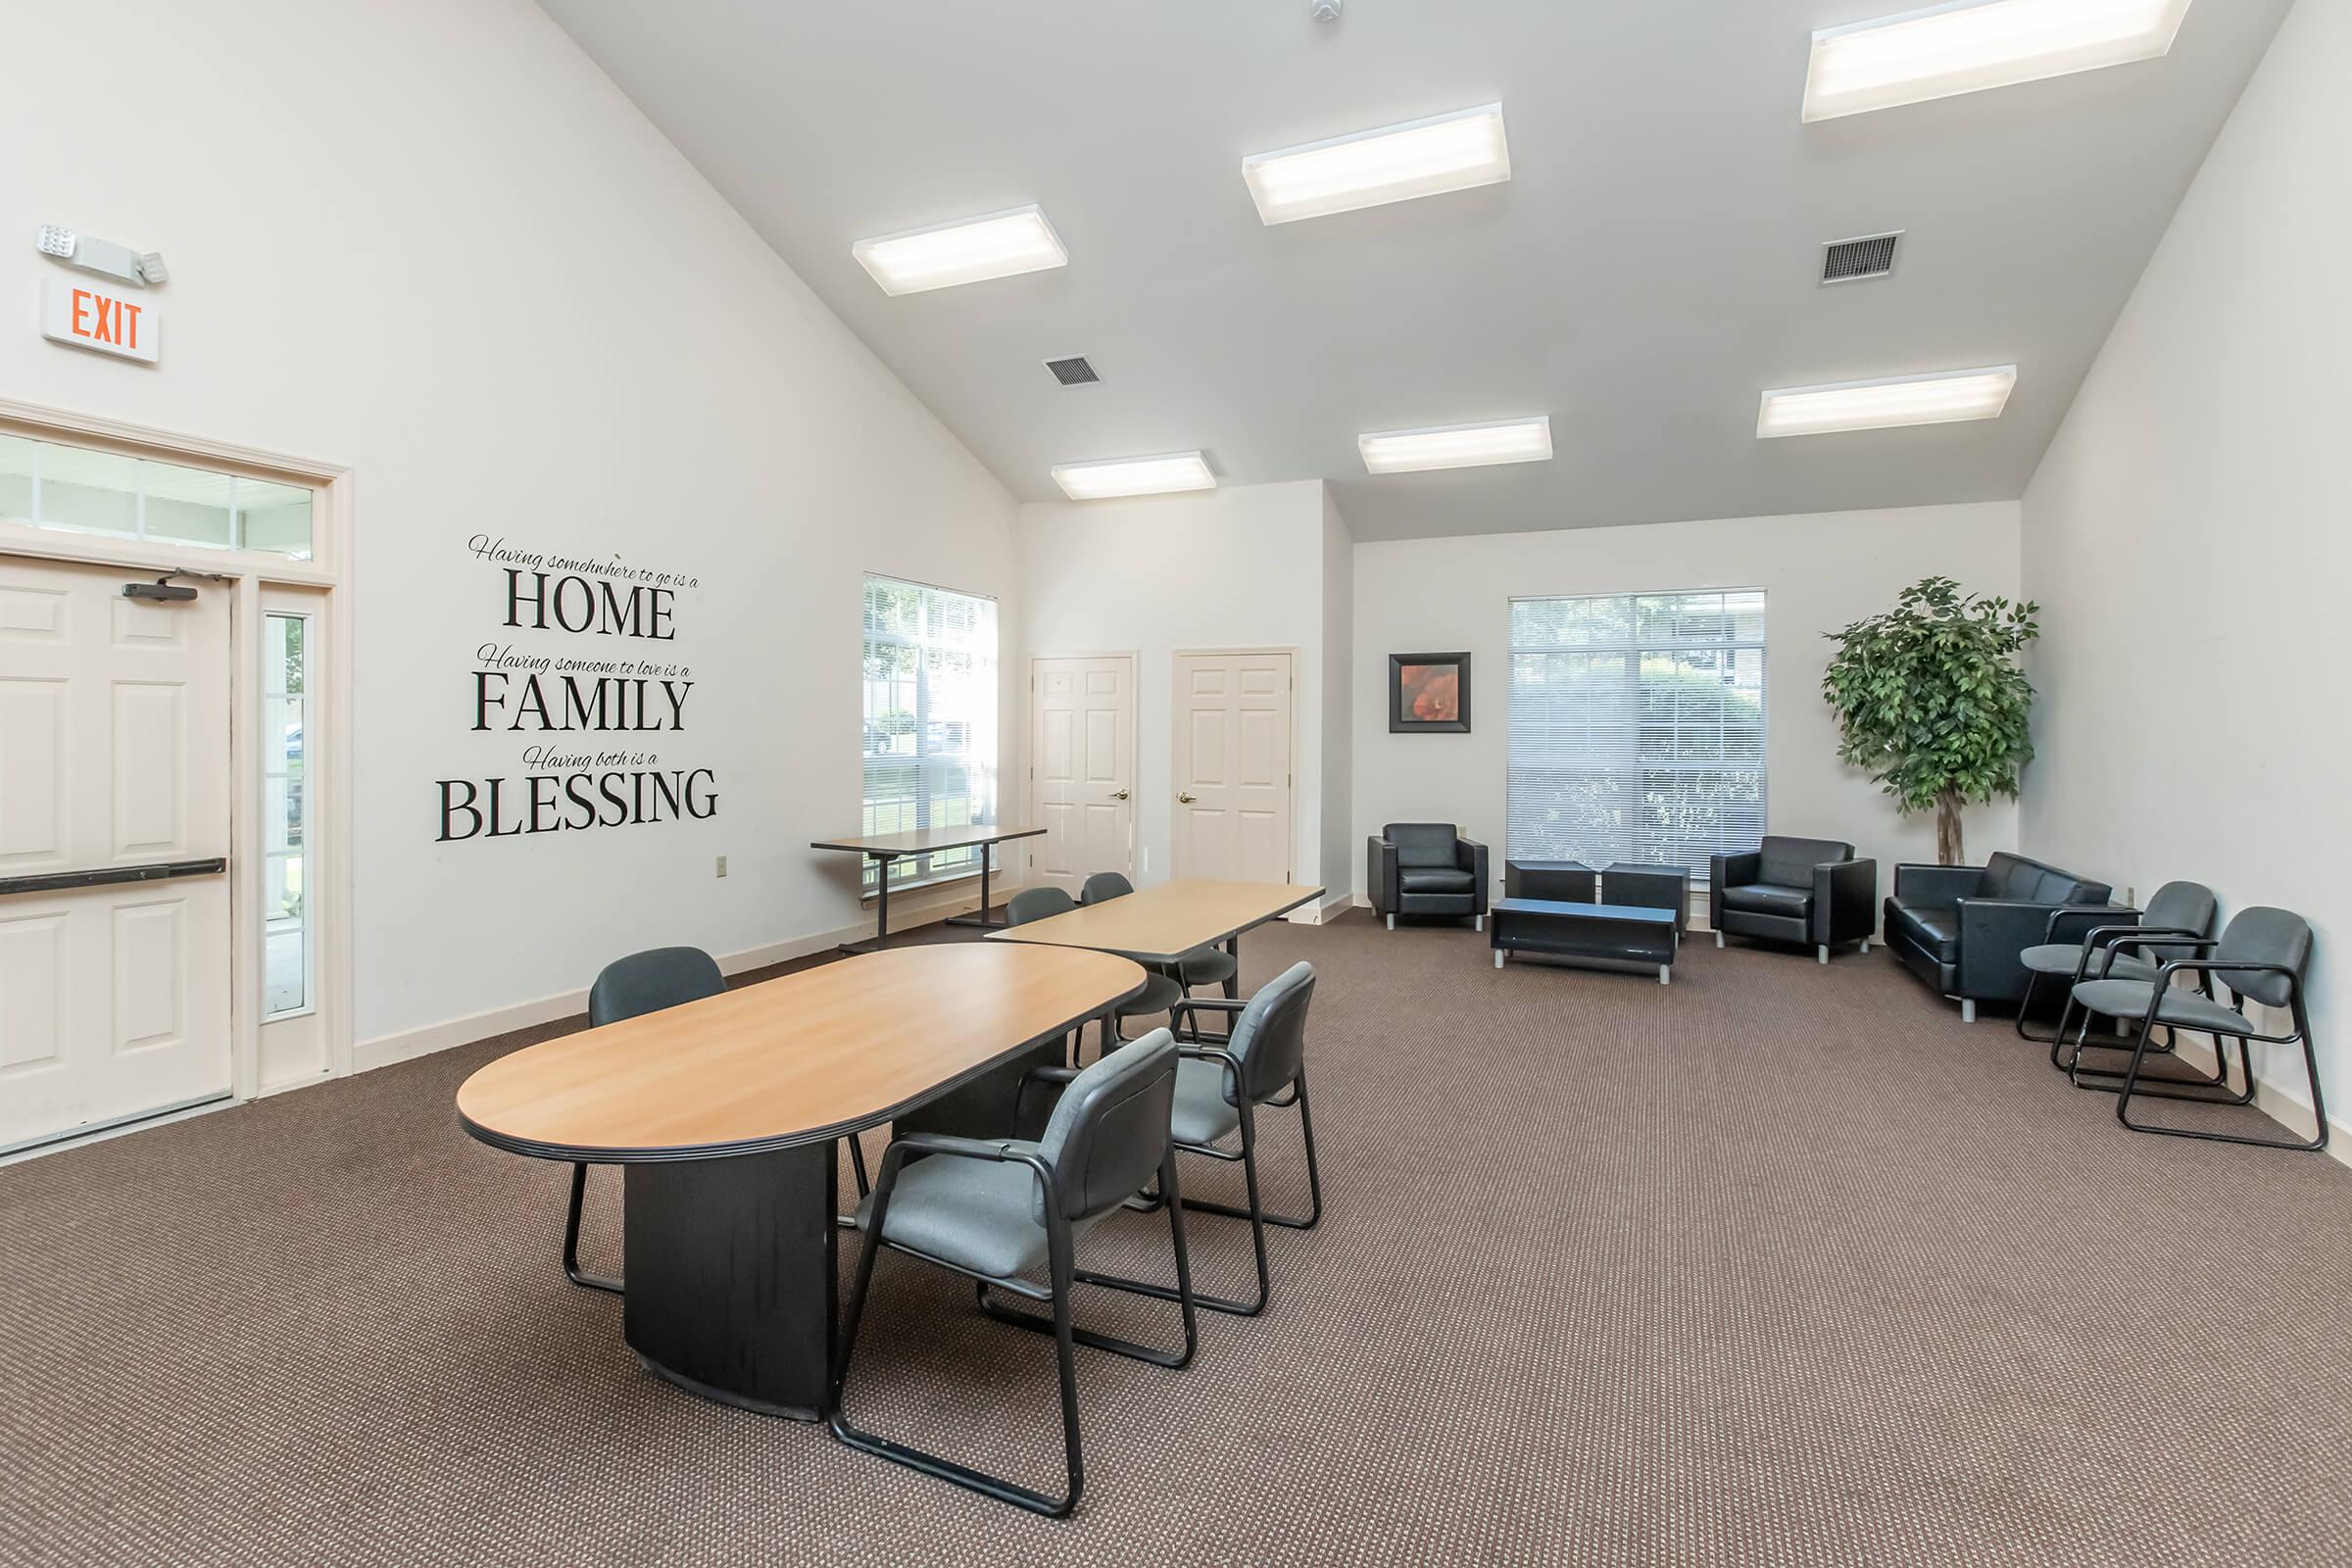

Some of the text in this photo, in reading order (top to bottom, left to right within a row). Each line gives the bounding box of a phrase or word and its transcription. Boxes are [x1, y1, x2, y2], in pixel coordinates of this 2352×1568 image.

[73, 288, 141, 349] EXIT
[467, 534, 543, 571] Having
[639, 568, 654, 582] to
[656, 572, 670, 588] go
[673, 573, 686, 587] is
[689, 577, 700, 588] a
[503, 567, 676, 640] HOME
[476, 642, 691, 677] Having someone to love is a
[470, 671, 695, 731] FAMILY
[522, 745, 659, 772] Having both is a
[435, 768, 719, 842] BLESSING
